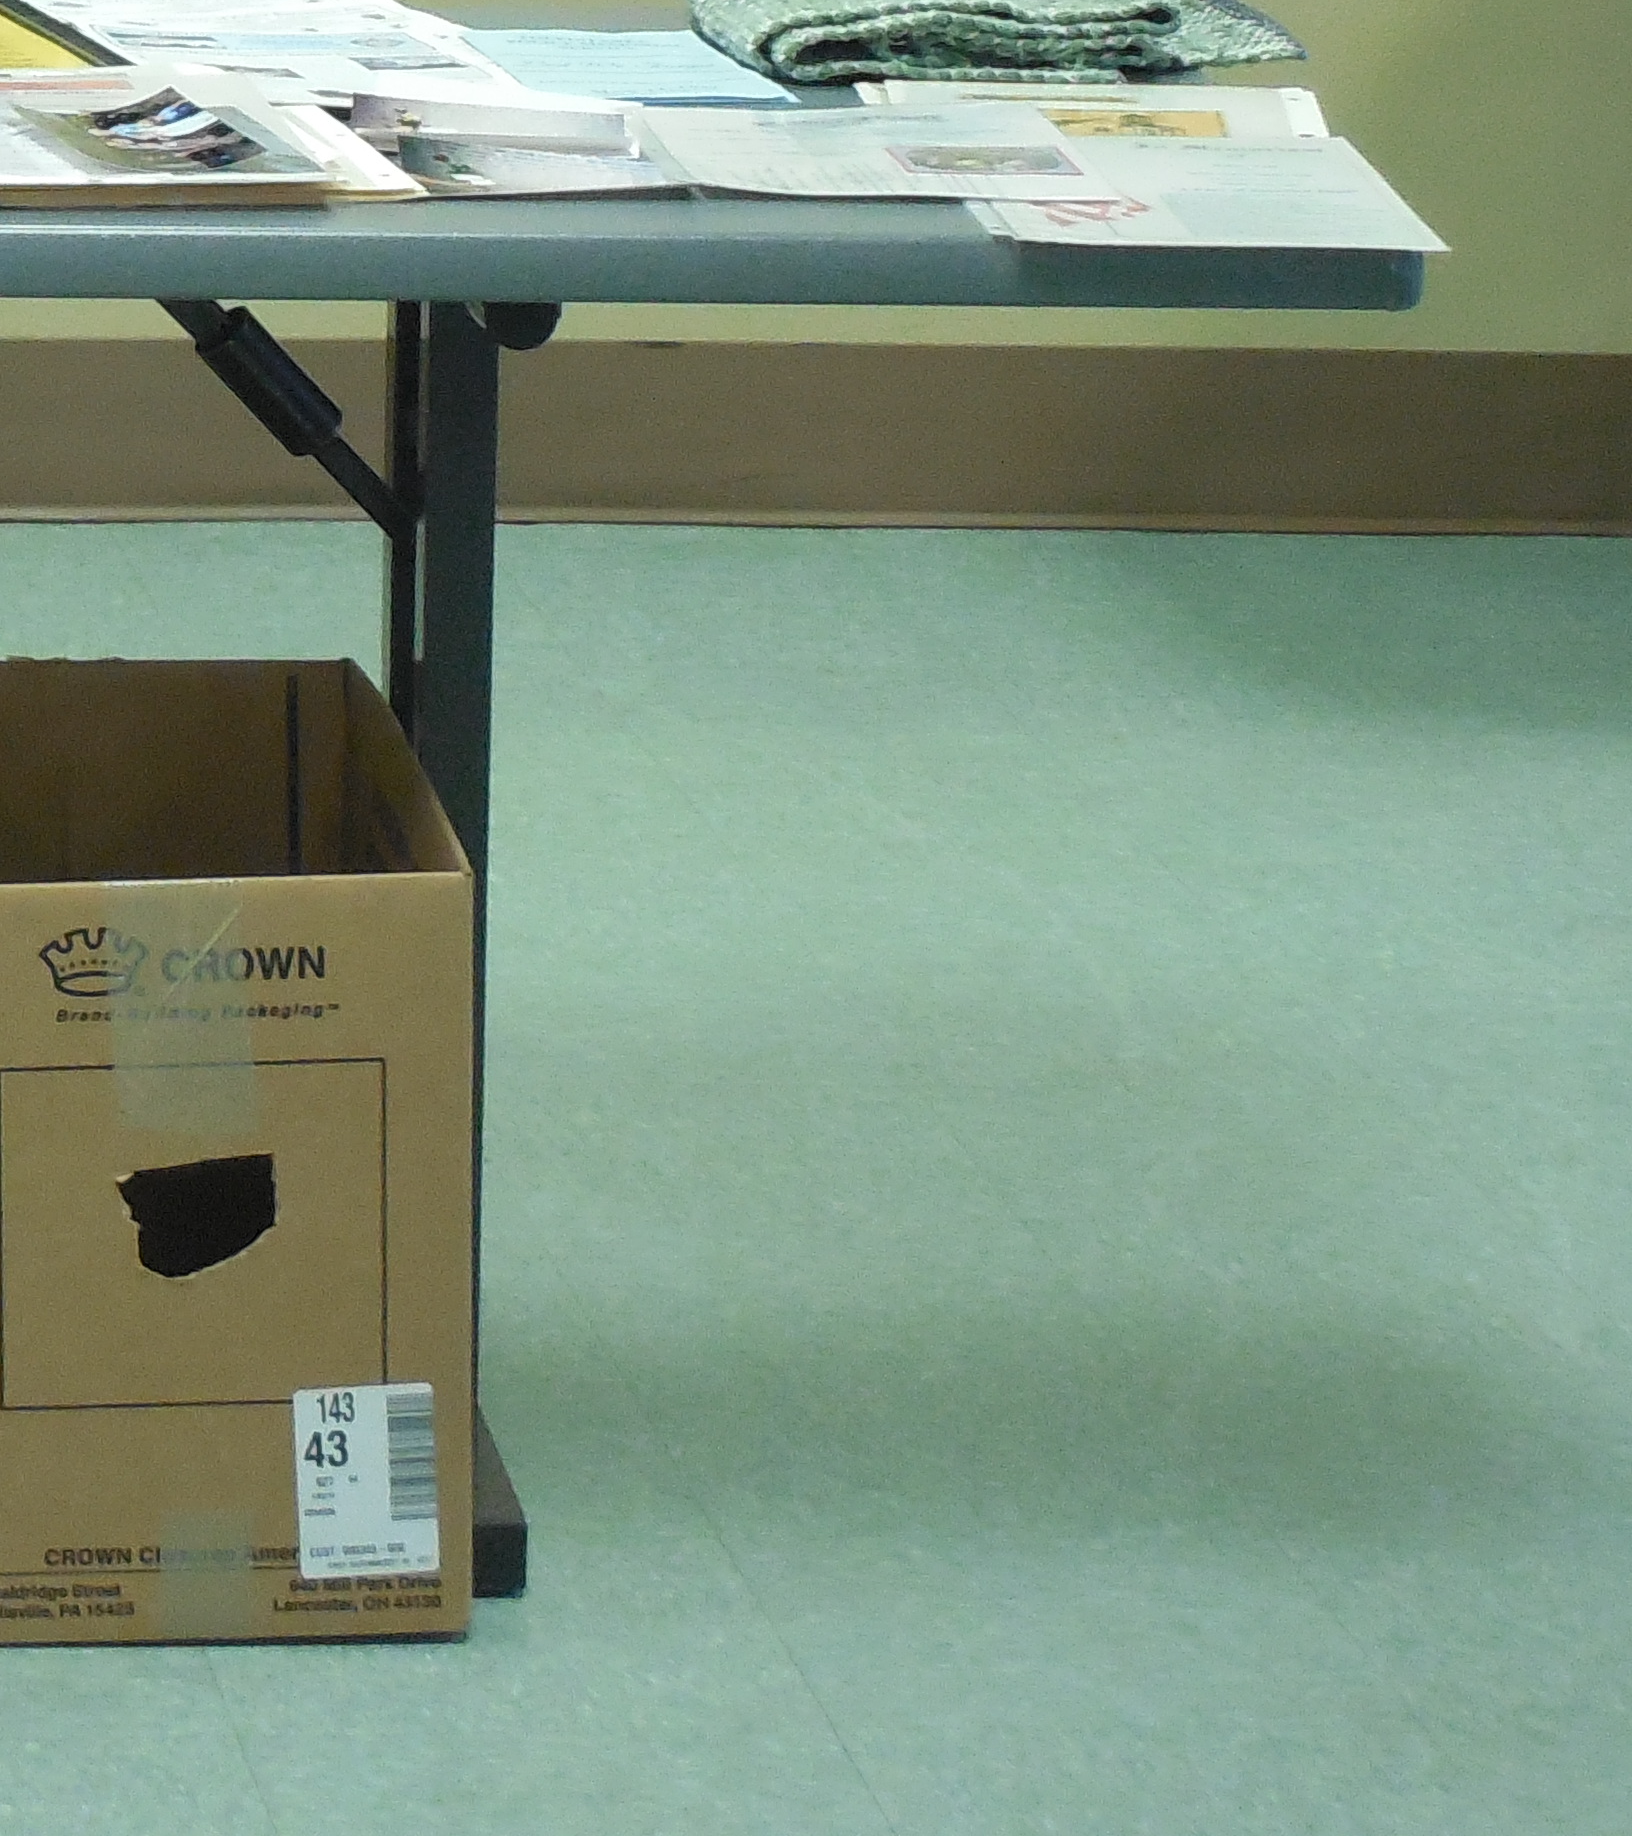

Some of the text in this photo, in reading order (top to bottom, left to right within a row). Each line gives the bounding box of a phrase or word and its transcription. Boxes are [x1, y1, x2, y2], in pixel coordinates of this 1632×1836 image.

[161, 945, 327, 983] CROWN
[316, 1391, 355, 1424] 143
[303, 1429, 349, 1469] 43
[44, 1547, 132, 1566] CROWN
[59, 1602, 81, 1618] PA
